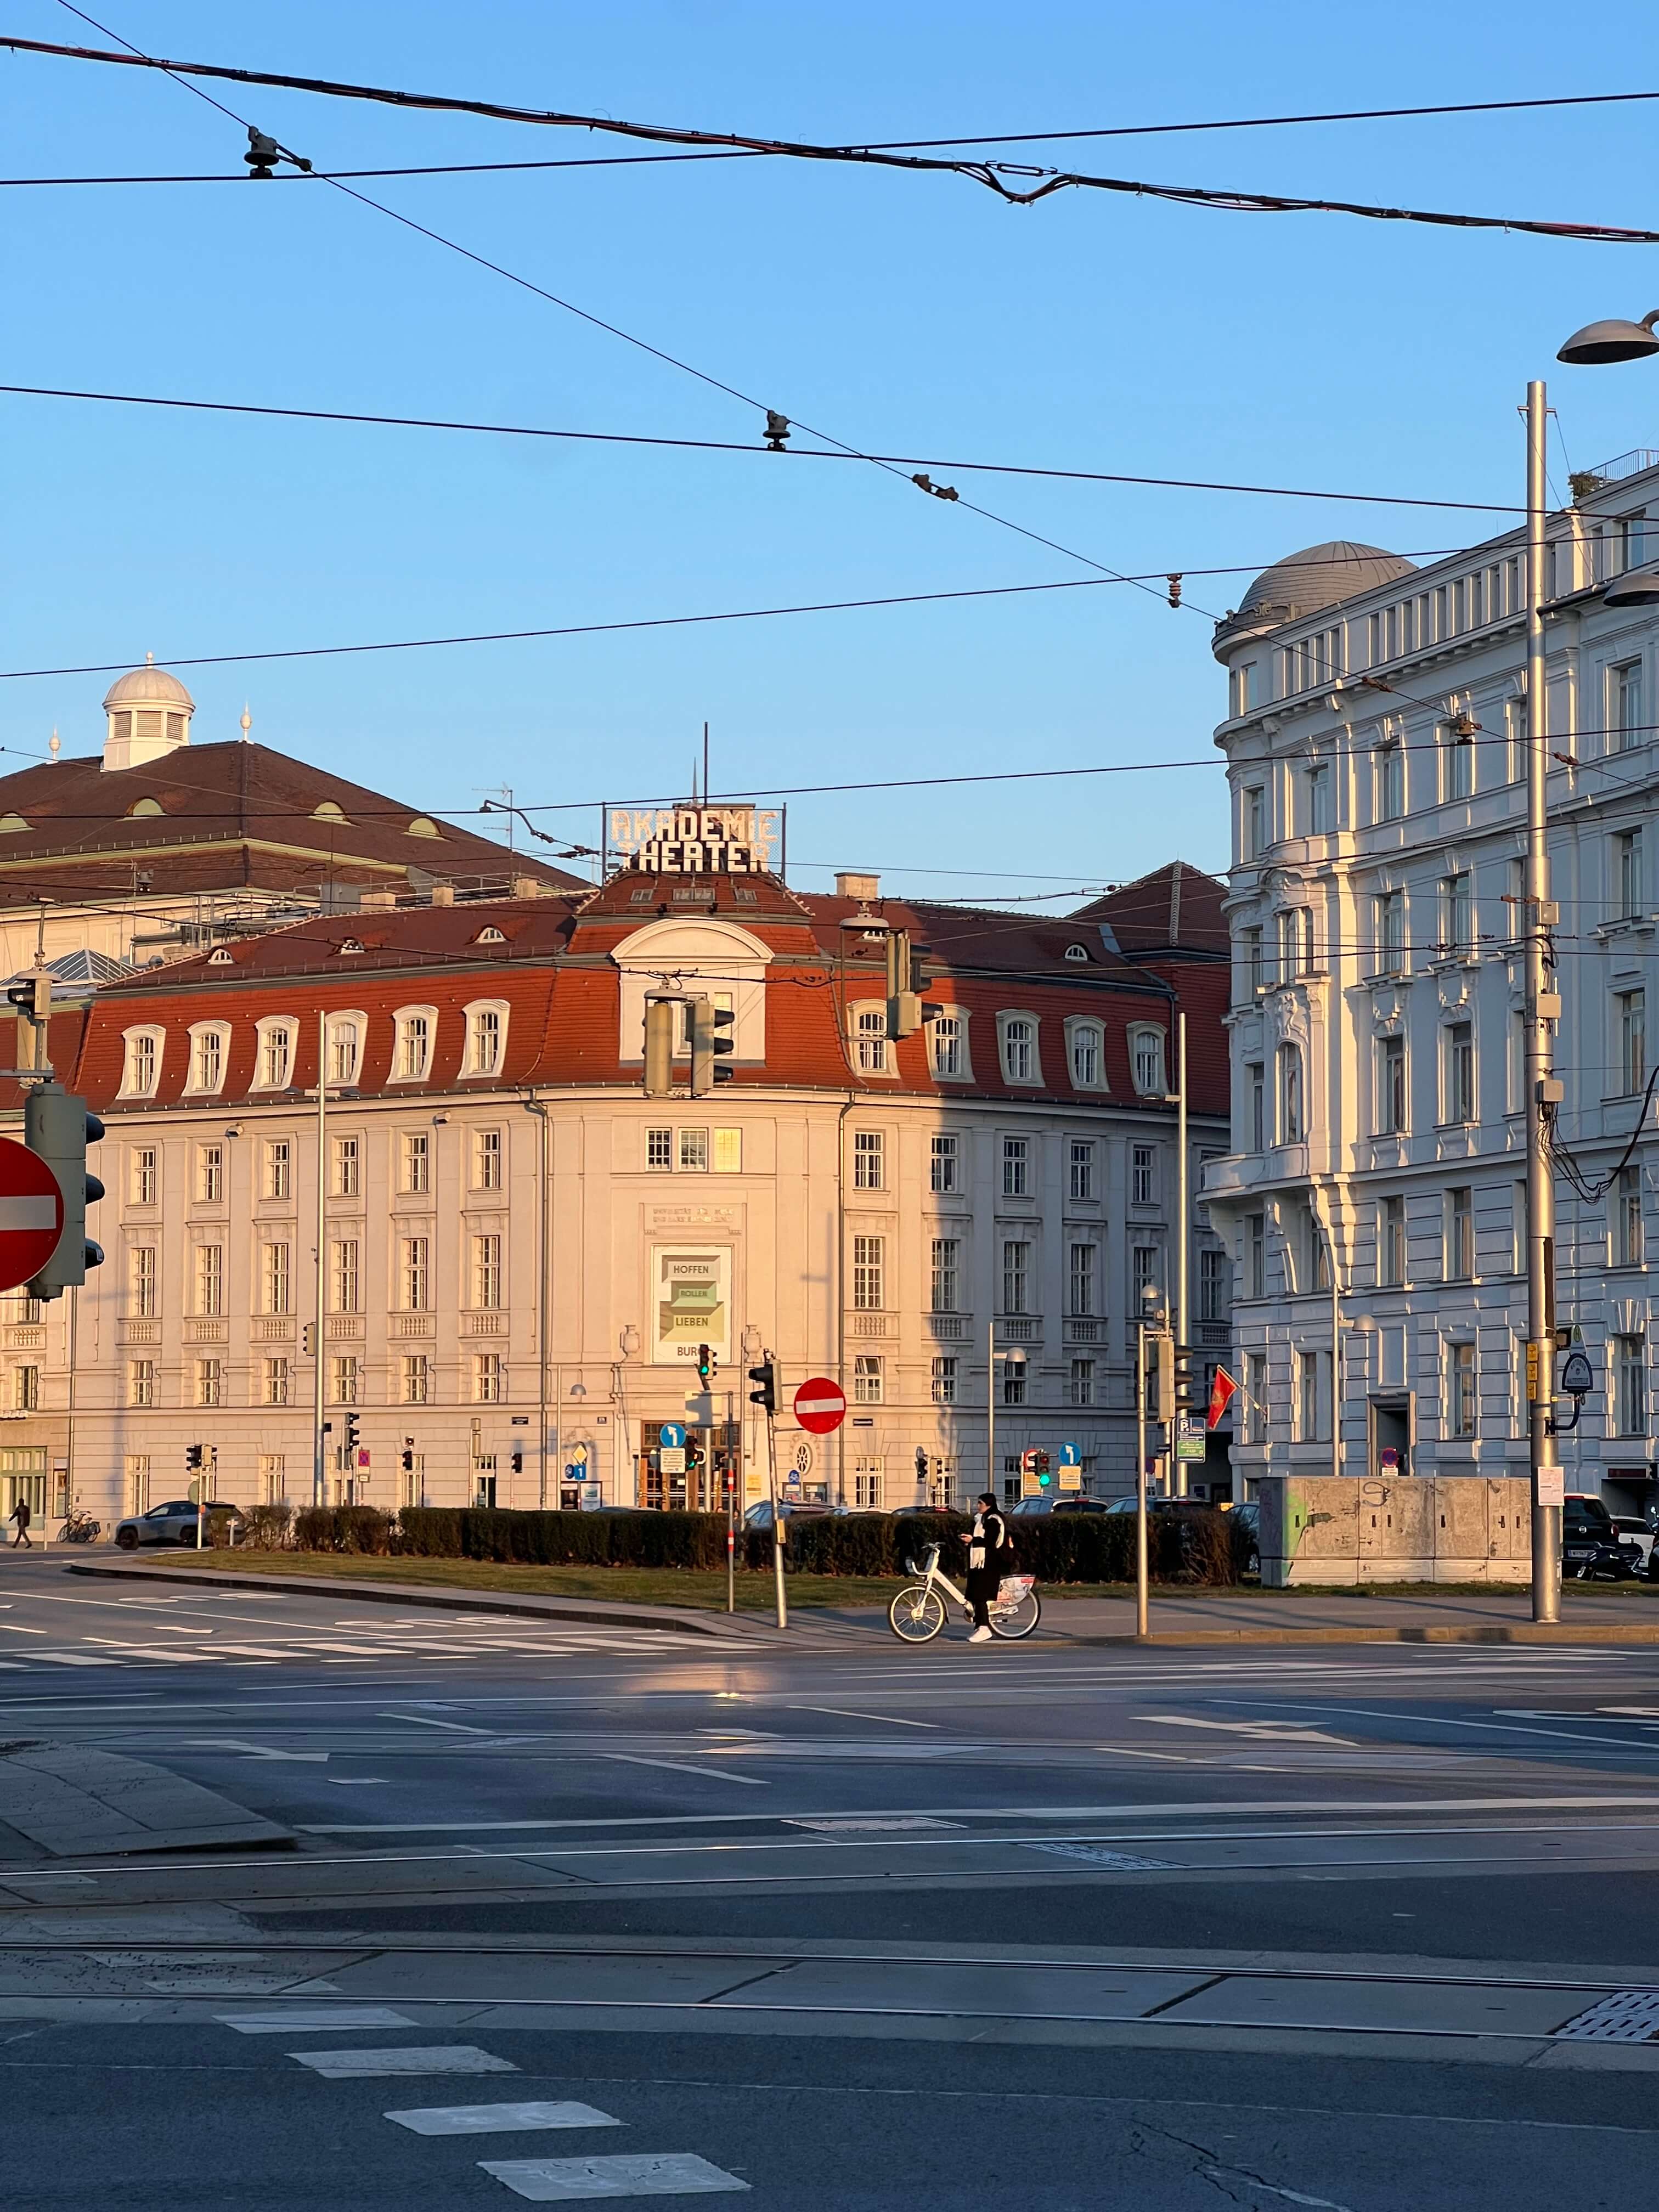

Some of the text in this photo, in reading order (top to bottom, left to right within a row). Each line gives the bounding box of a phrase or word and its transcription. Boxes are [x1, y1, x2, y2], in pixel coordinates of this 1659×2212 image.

[611, 810, 777, 842] AKADEMIE
[617, 840, 770, 873] THEATER
[673, 1265, 709, 1273] HOFFEN
[675, 1317, 708, 1326] LIEBEN
[677, 1347, 701, 1356] BUR
